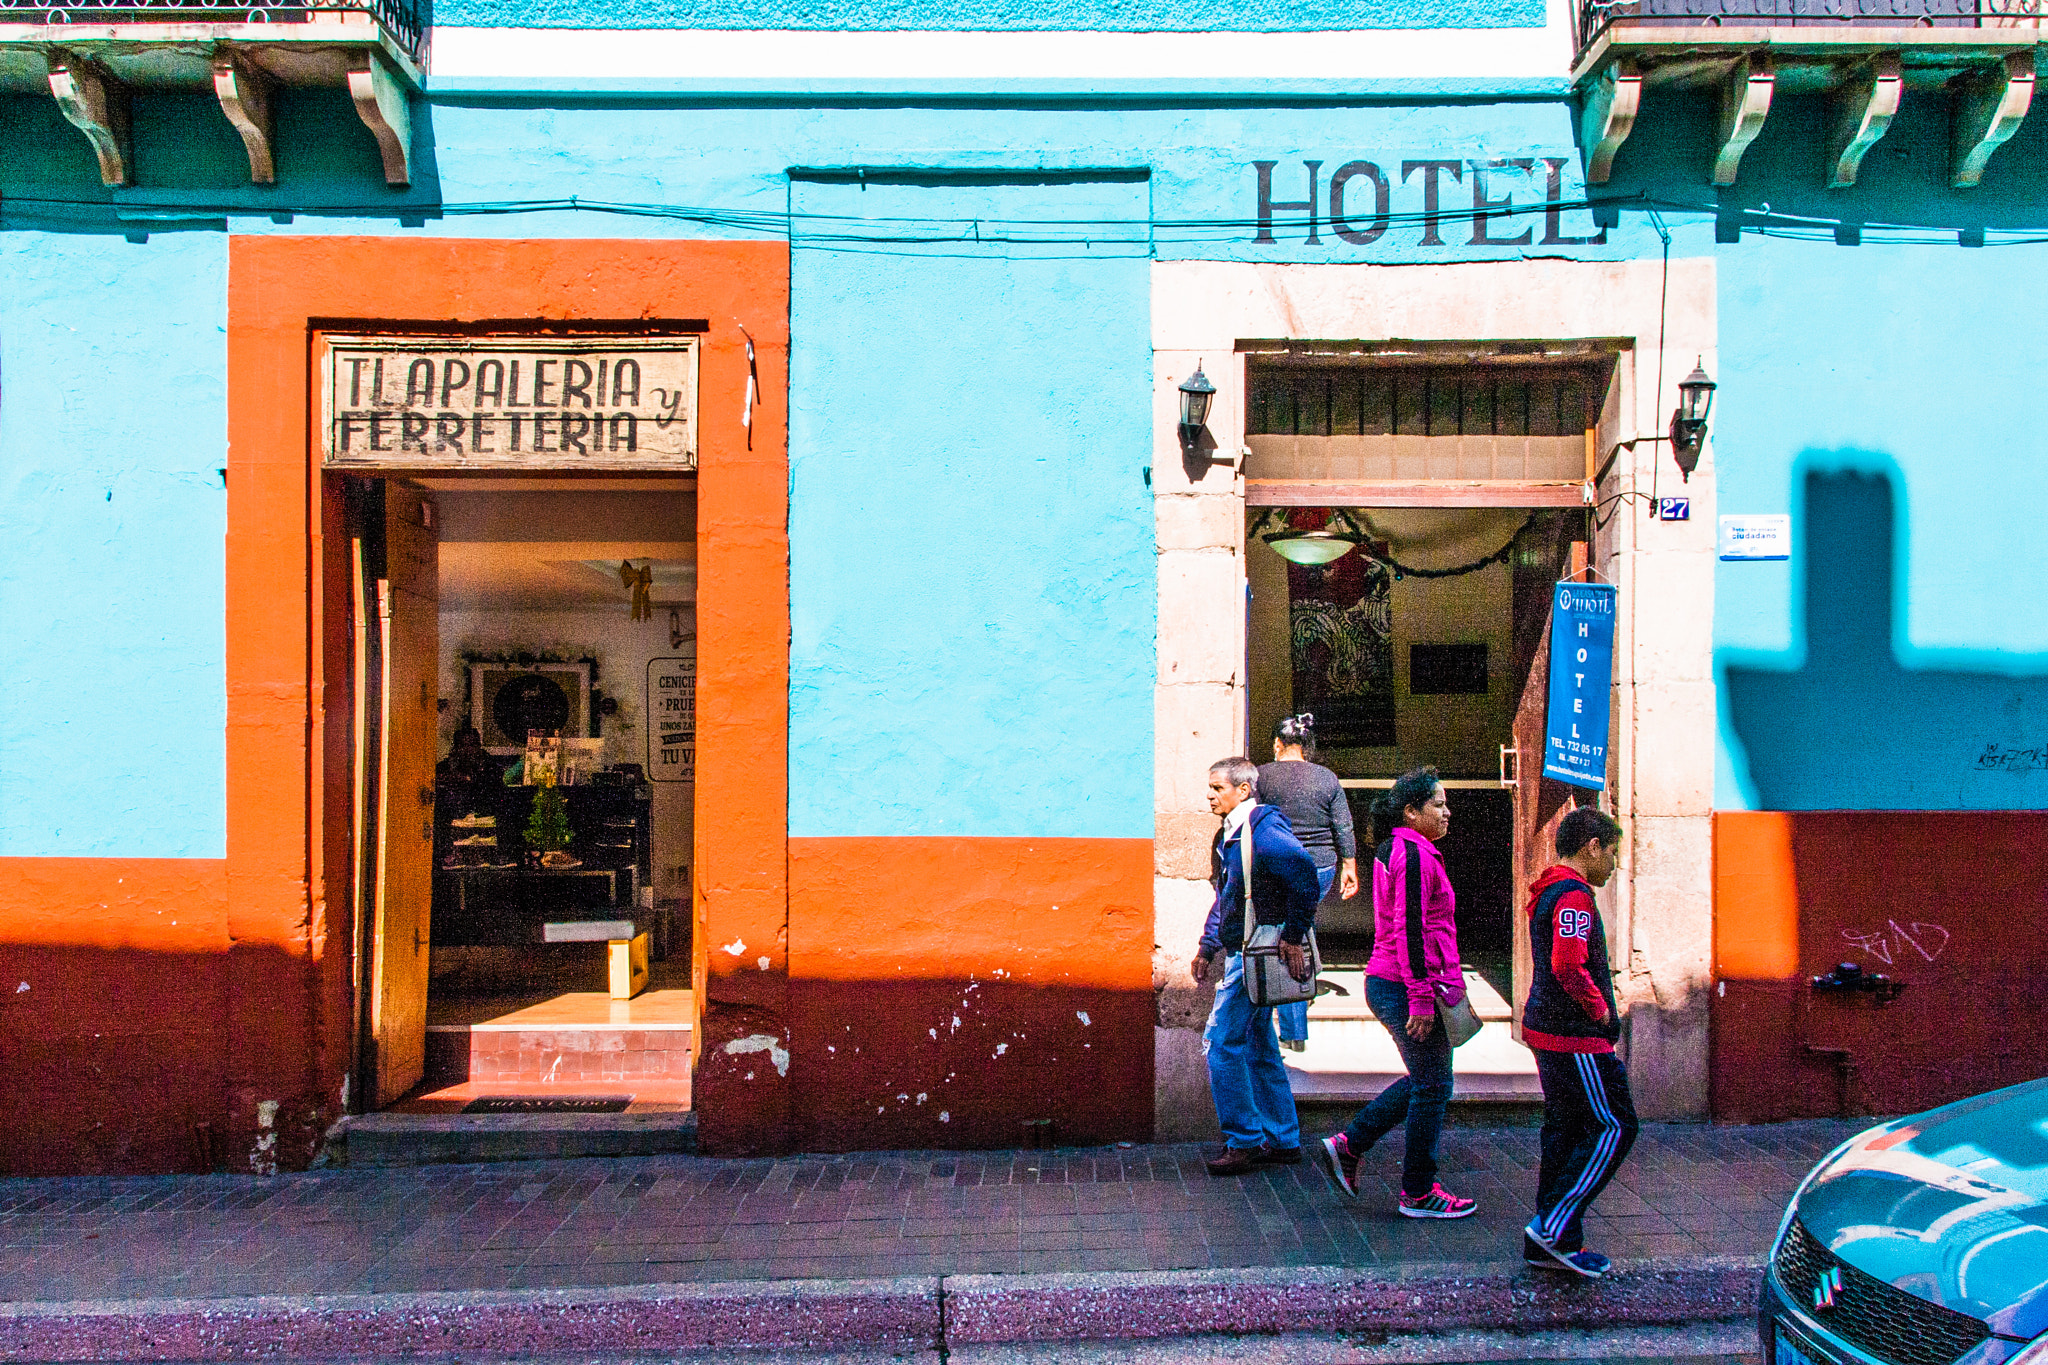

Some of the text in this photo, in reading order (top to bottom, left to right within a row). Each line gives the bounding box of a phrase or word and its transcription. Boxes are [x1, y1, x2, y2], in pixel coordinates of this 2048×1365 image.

[1251, 158, 1607, 246] HOTEL
[343, 358, 641, 409] TLAPALERIA
[340, 411, 638, 456] FERRETERIA
[1662, 499, 1688, 518] 27
[1732, 532, 1776, 540] ciudadano
[1572, 622, 1588, 739] HOTEL
[660, 722, 682, 731] UNOS
[661, 749, 679, 764] TU
[1567, 741, 1580, 752] 732
[1581, 744, 1590, 755] 05
[1593, 746, 1603, 757] 17
[1559, 908, 1590, 942] 92
